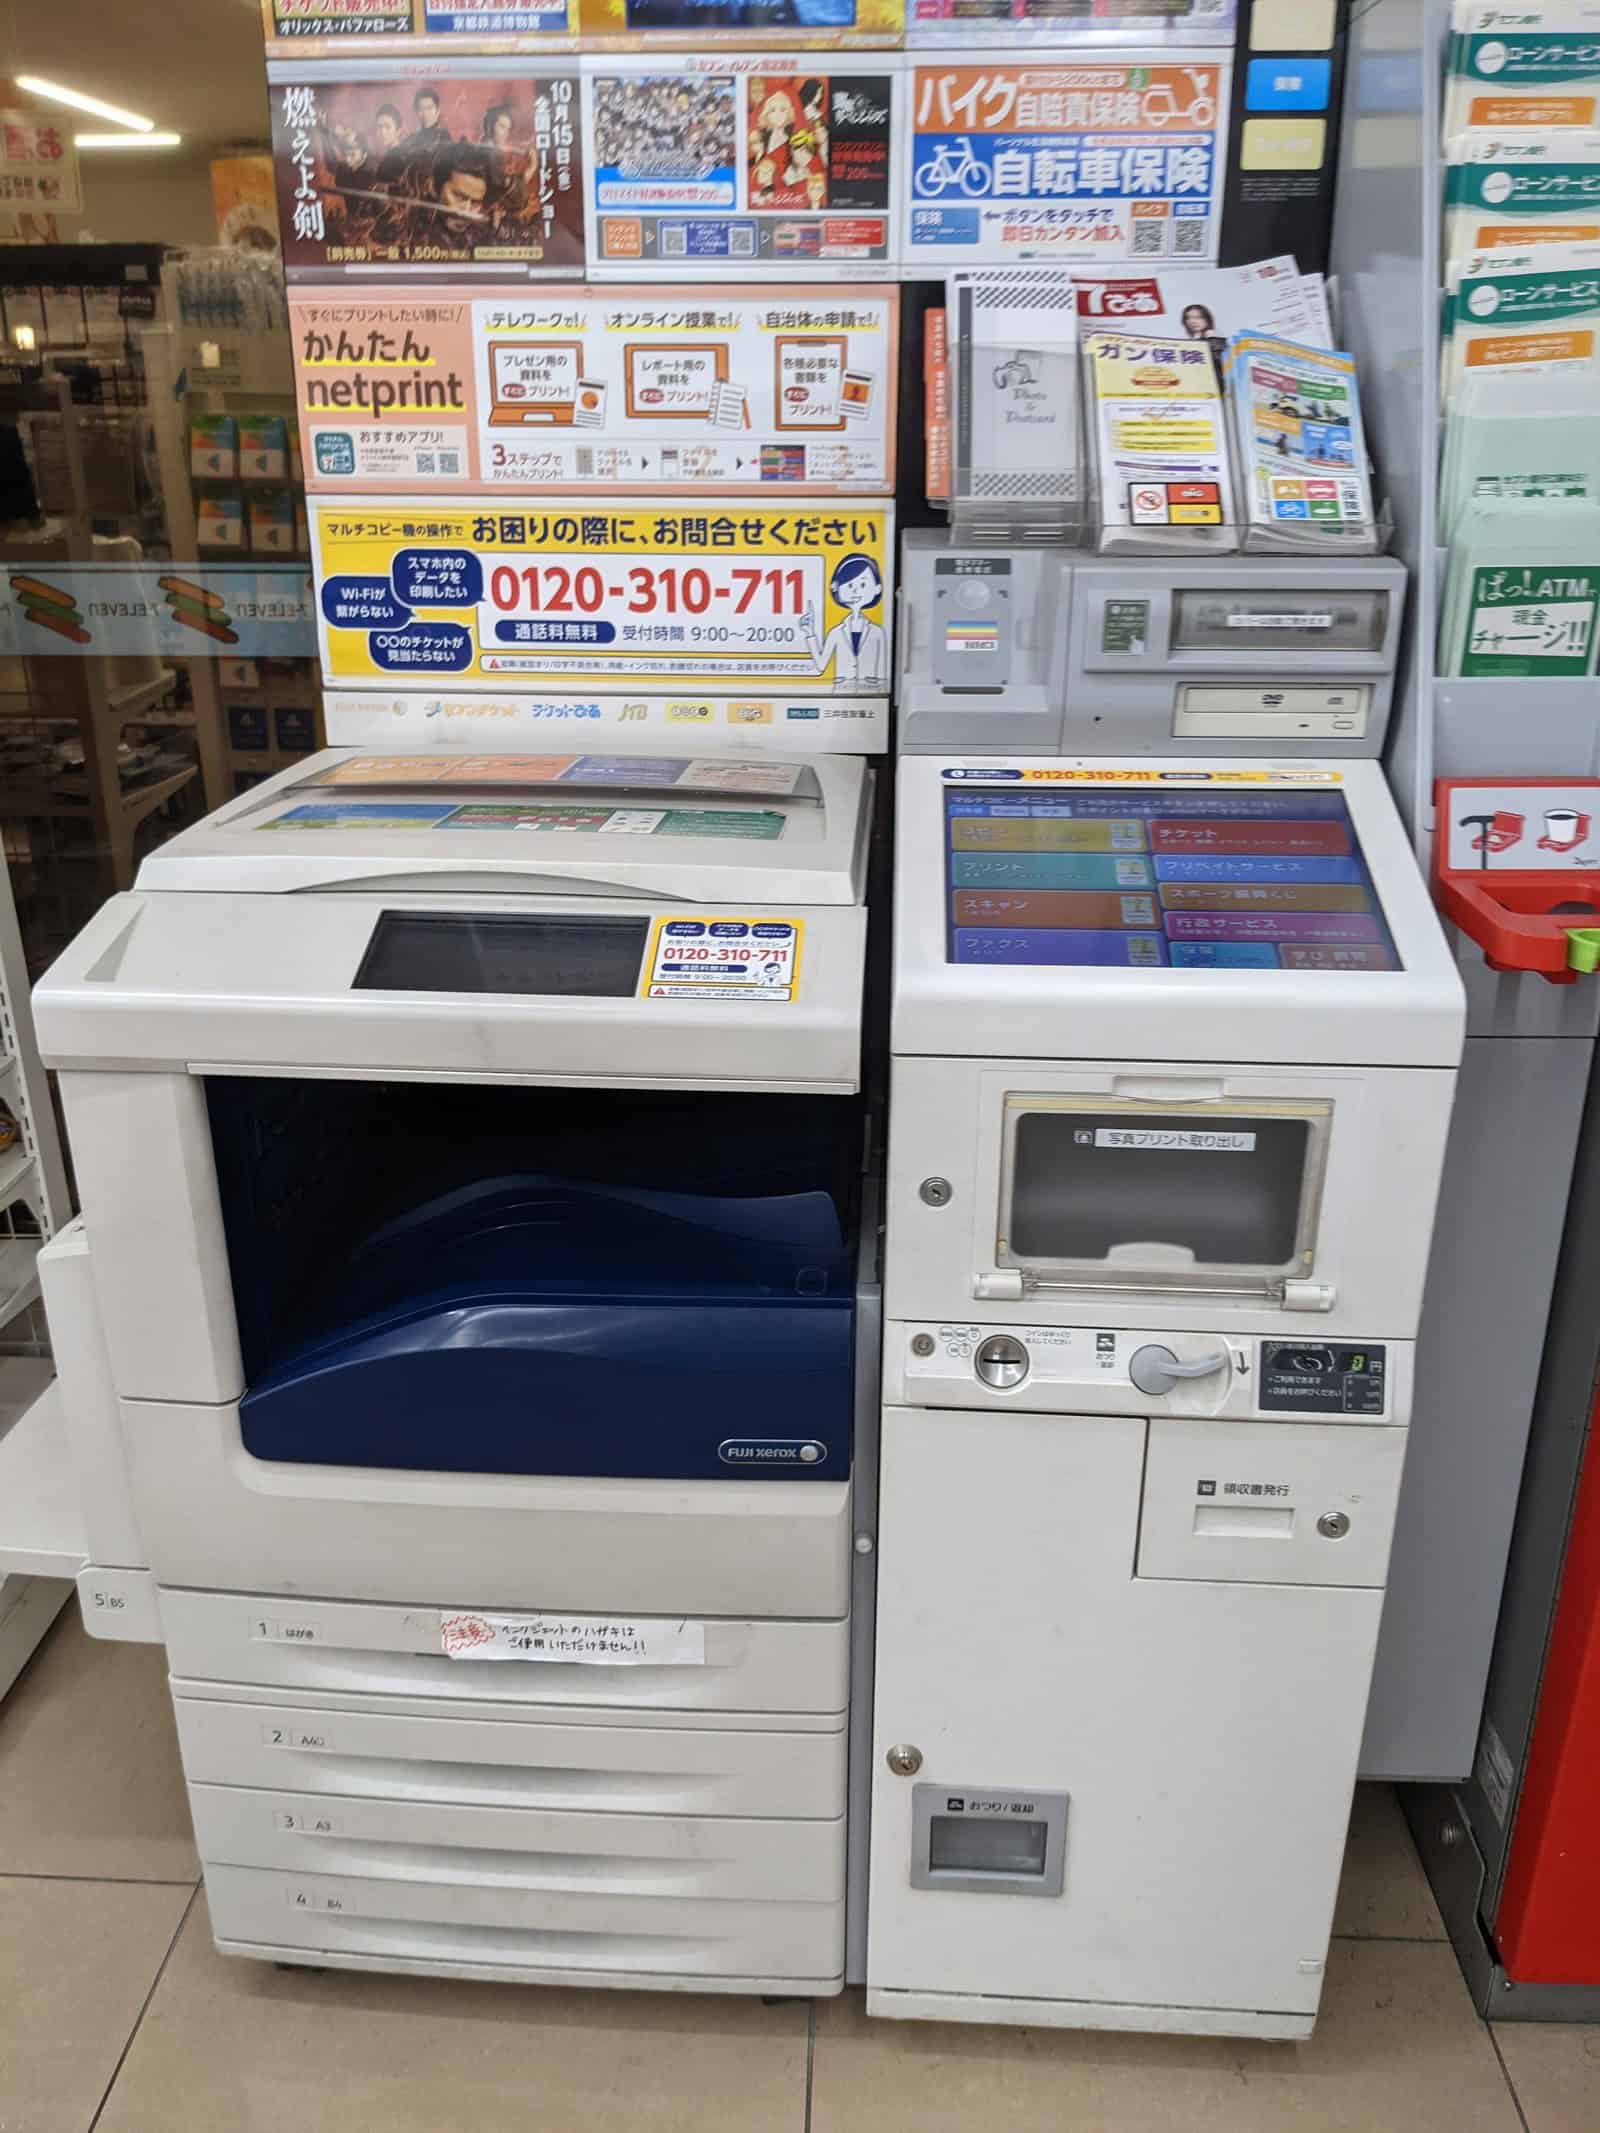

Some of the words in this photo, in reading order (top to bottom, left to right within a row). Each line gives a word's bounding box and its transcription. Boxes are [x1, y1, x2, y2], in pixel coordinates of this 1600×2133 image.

[917, 74, 1017, 129] バイク
[1016, 92, 1141, 128] 自賠責保険
[283, 87, 325, 241] 燃えよ剣
[534, 95, 555, 239] 全国ロードショー
[991, 148, 1209, 197] 自転車保険
[1001, 208, 1115, 224] ボタンをタッチで
[1001, 225, 1126, 242] 即日カンタン加入
[492, 312, 579, 329] テレワークで!
[611, 312, 733, 329] オンライン授業で!
[766, 311, 873, 329] 自治体の申請で!
[303, 330, 431, 362] かんたん
[503, 355, 568, 368] プレゼン用の
[1096, 343, 1208, 366] ガン保険
[642, 360, 706, 372] レポート用の
[520, 369, 552, 382] 資料を
[657, 373, 689, 386] 資料を
[307, 370, 464, 419] netprint
[360, 431, 445, 444] おすすめアプリ!
[491, 443, 562, 466] 3ステップで
[327, 522, 463, 538] マルチコピー機の操作で
[472, 517, 878, 547] お困りの際に、お問合せください
[407, 557, 466, 570] スマホ内の
[414, 572, 462, 584] データを
[341, 587, 386, 600] Wi-Fiが
[409, 585, 468, 599] 印刷したい
[491, 565, 804, 615] 0120-310-711
[1511, 609, 1549, 626] 現金
[514, 623, 599, 641] 通話料無料
[622, 625, 685, 642] 受付時間
[1472, 620, 1590, 652] チャージ!!
[388, 650, 456, 663] 見当たらない
[531, 703, 601, 718] チケットぴあ
[618, 703, 649, 722] JTB
[1032, 771, 1150, 780] 0120-310-711
[963, 862, 1024, 872] プリント
[1175, 917, 1279, 929] 行政サービス
[663, 947, 787, 962] 0120-310-711
[1108, 1132, 1245, 1148] 写真プリント取り出し
[755, 1447, 797, 1458] xerox
[1223, 1483, 1289, 1496] 領収書発行
[95, 1593, 105, 1606] 5
[258, 1622, 267, 1636] 1
[271, 1730, 283, 1744] 2
[284, 1815, 295, 1829] 3
[296, 1893, 307, 1905] 4
